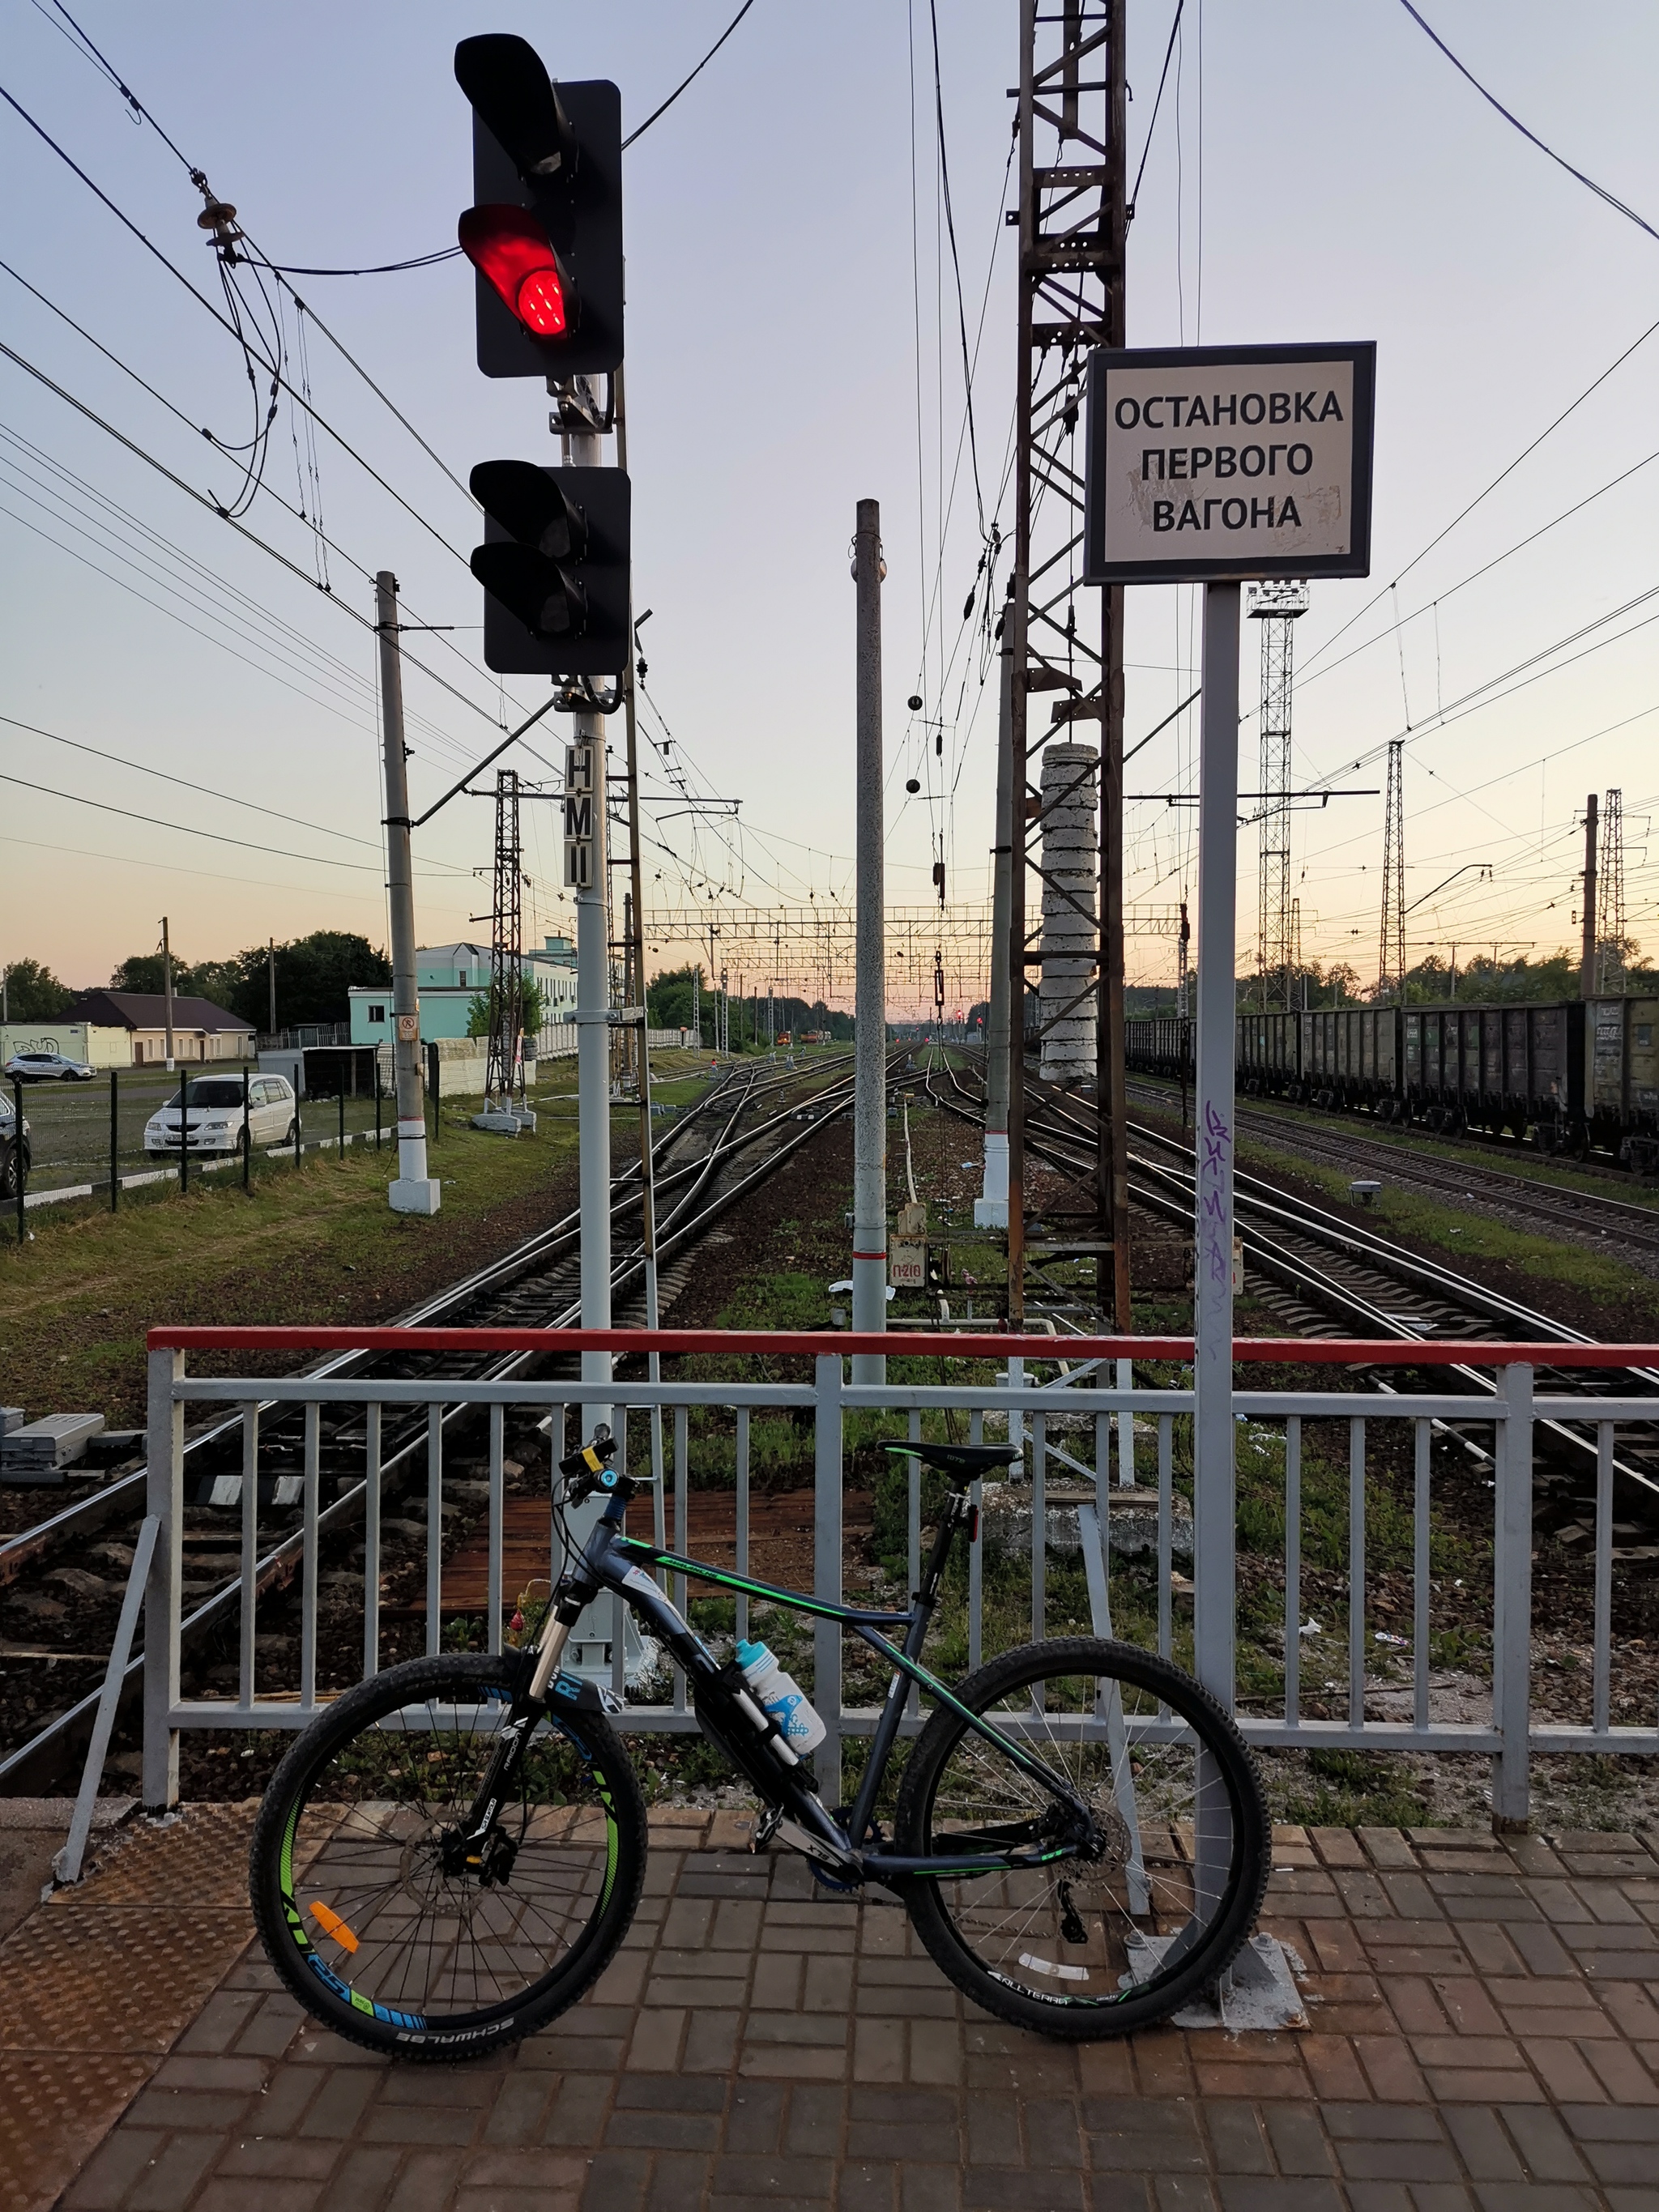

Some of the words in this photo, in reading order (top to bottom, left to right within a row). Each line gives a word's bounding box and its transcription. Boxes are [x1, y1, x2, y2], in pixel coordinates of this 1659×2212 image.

[1115, 390, 1344, 430] ОСТАНОВКА
[1141, 443, 1313, 480] ПЕРВОГО
[1153, 496, 1302, 532] ВАГОНА
[504, 1732, 522, 1771] RAIDON
[395, 2016, 514, 2045] SCHWALBE
